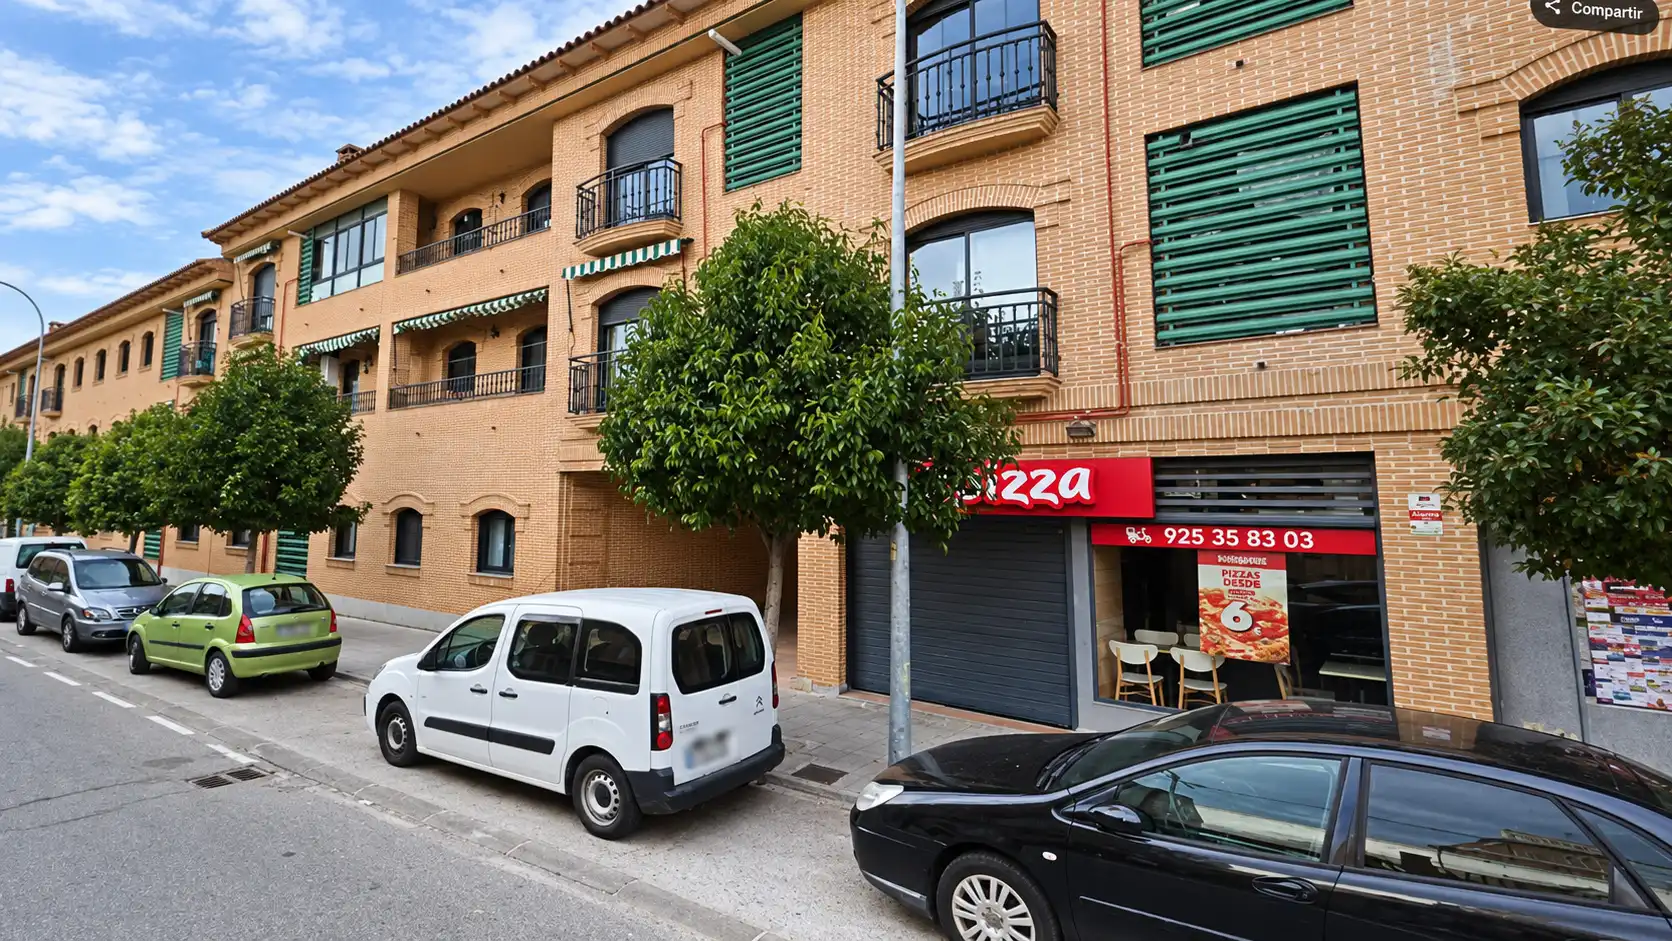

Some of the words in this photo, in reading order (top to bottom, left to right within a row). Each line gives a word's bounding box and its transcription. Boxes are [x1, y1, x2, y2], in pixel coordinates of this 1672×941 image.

[1164, 527, 1205, 545] 925
[1211, 528, 1239, 546] 35
[1247, 530, 1276, 548] 83
[1283, 531, 1314, 549] 03
[1221, 569, 1261, 580] PIZZAS
[1223, 578, 1262, 589] DESDE
[1220, 600, 1254, 632] 6
